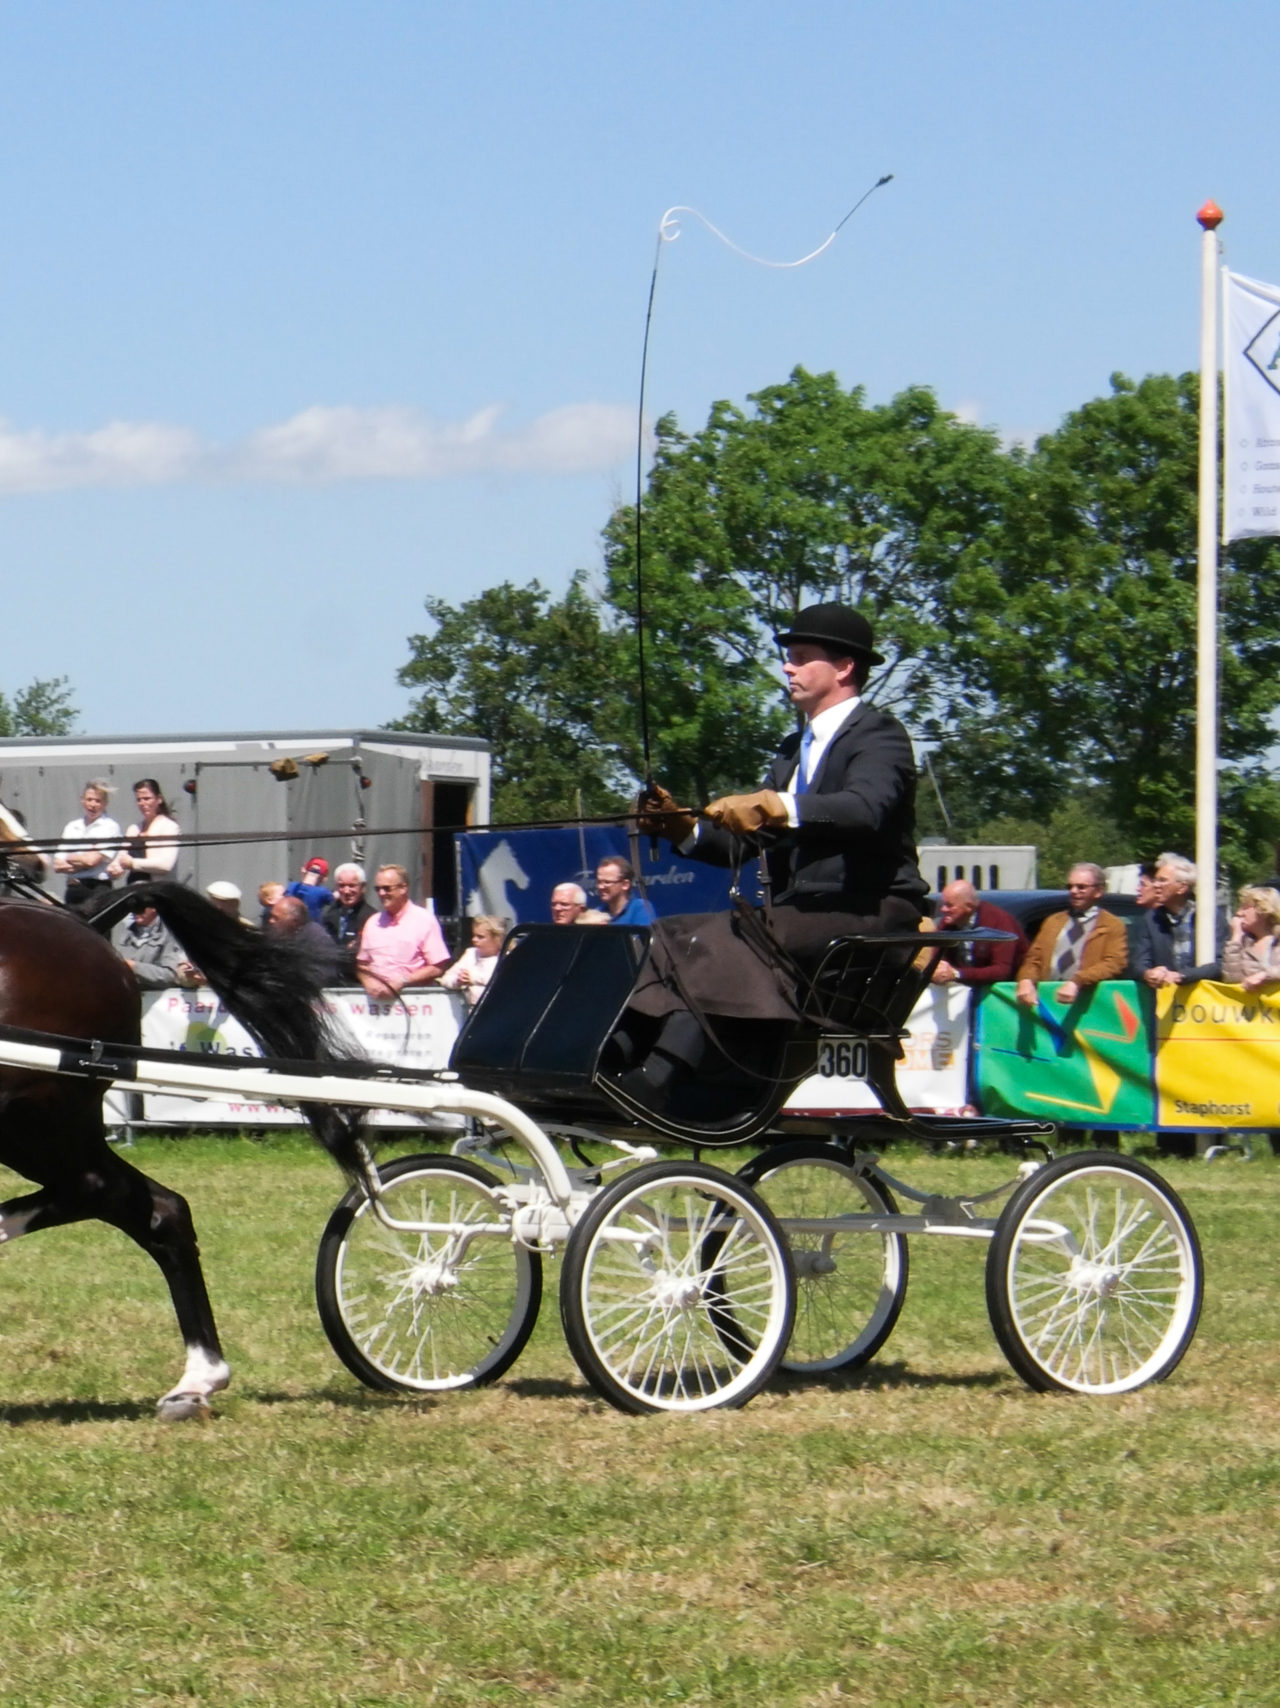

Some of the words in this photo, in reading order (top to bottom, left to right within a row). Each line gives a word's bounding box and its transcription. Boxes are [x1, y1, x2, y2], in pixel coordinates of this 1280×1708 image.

[350, 1003, 433, 1017] wassen
[820, 1041, 867, 1079] 360
[1174, 1099, 1253, 1117] Staphorst
